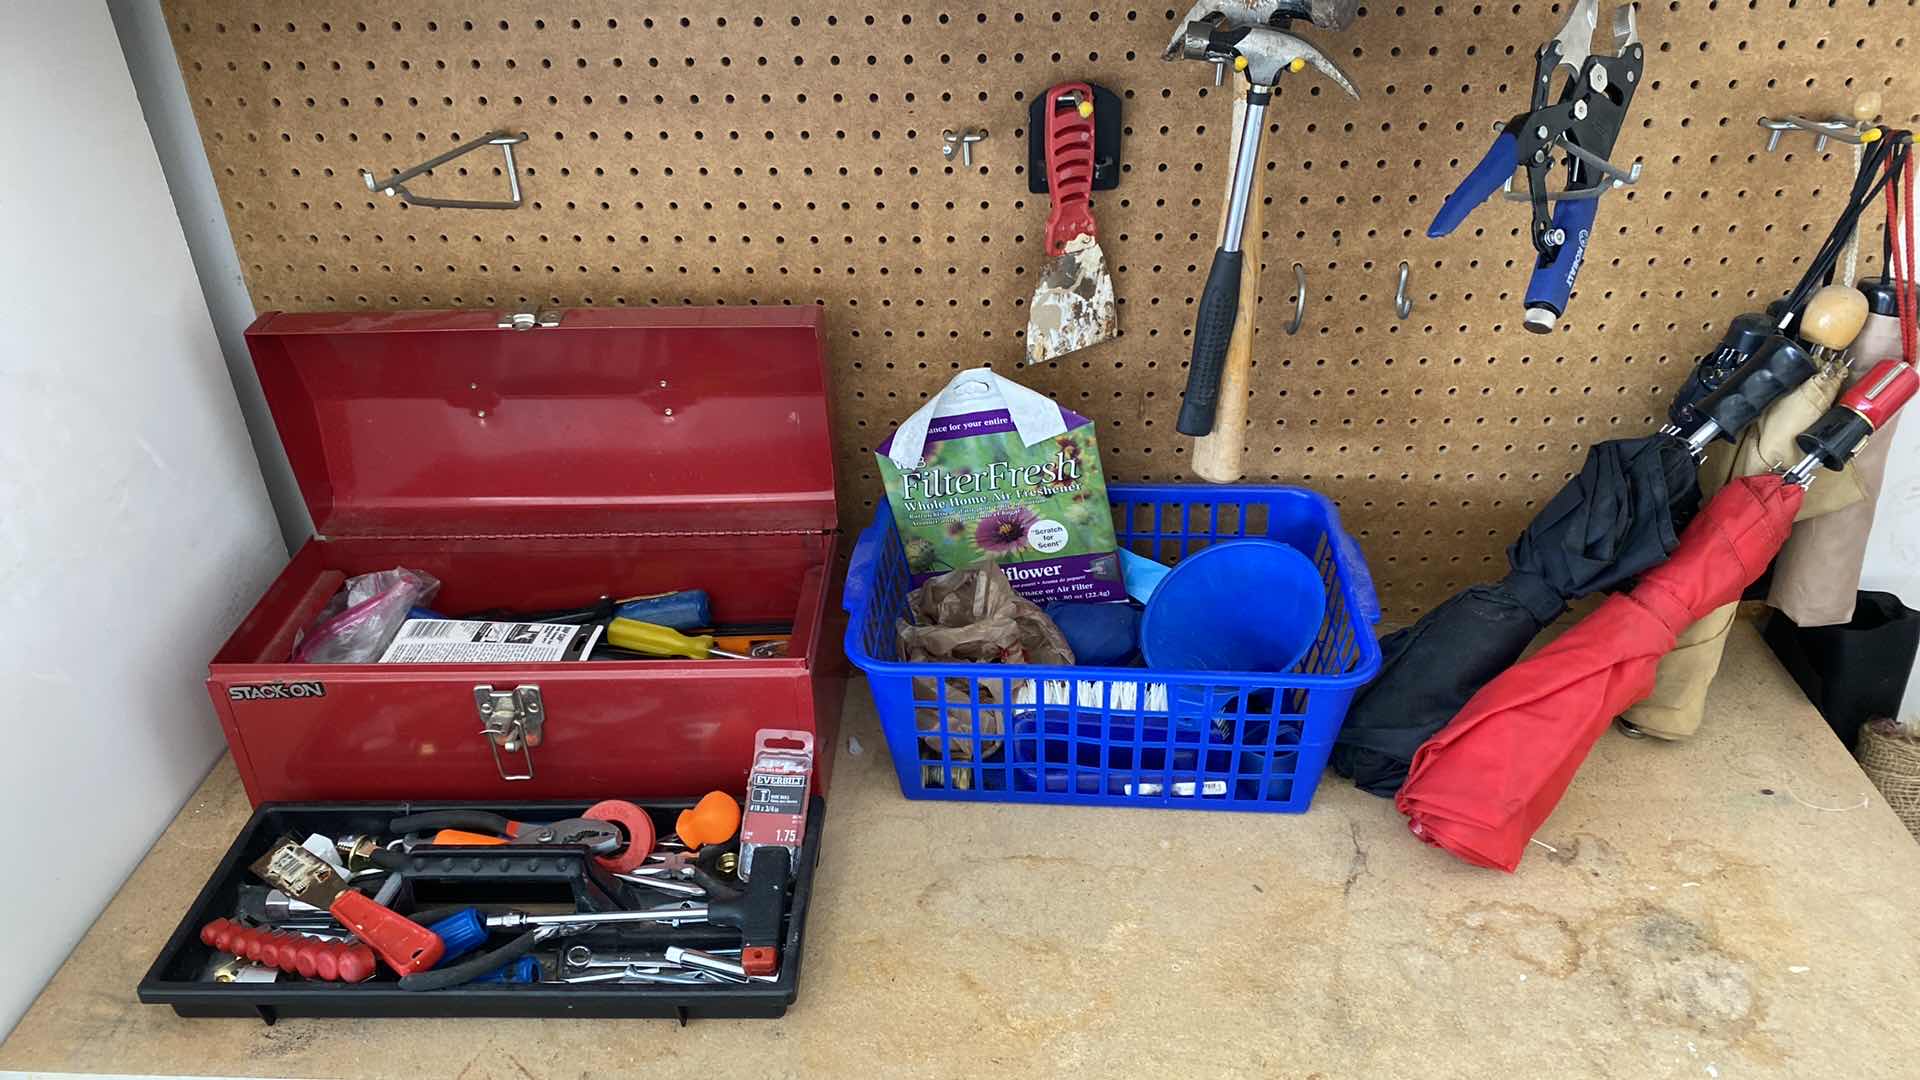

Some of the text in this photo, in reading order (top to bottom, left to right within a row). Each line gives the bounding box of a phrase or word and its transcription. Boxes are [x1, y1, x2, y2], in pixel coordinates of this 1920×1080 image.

[1566, 246, 1583, 288] KOBALT
[927, 417, 1008, 434] ance for your entire
[902, 452, 1081, 500] FilterFresh
[904, 500, 947, 512] Whole
[950, 495, 987, 507] Home
[992, 491, 1011, 502] Air
[1016, 483, 1082, 498] Freshener
[1057, 585, 1070, 593] Air
[1071, 583, 1094, 591] Filter
[229, 683, 322, 700] STACK-ON
[757, 775, 803, 785] EVERBILT
[776, 829, 796, 842] 1.75
